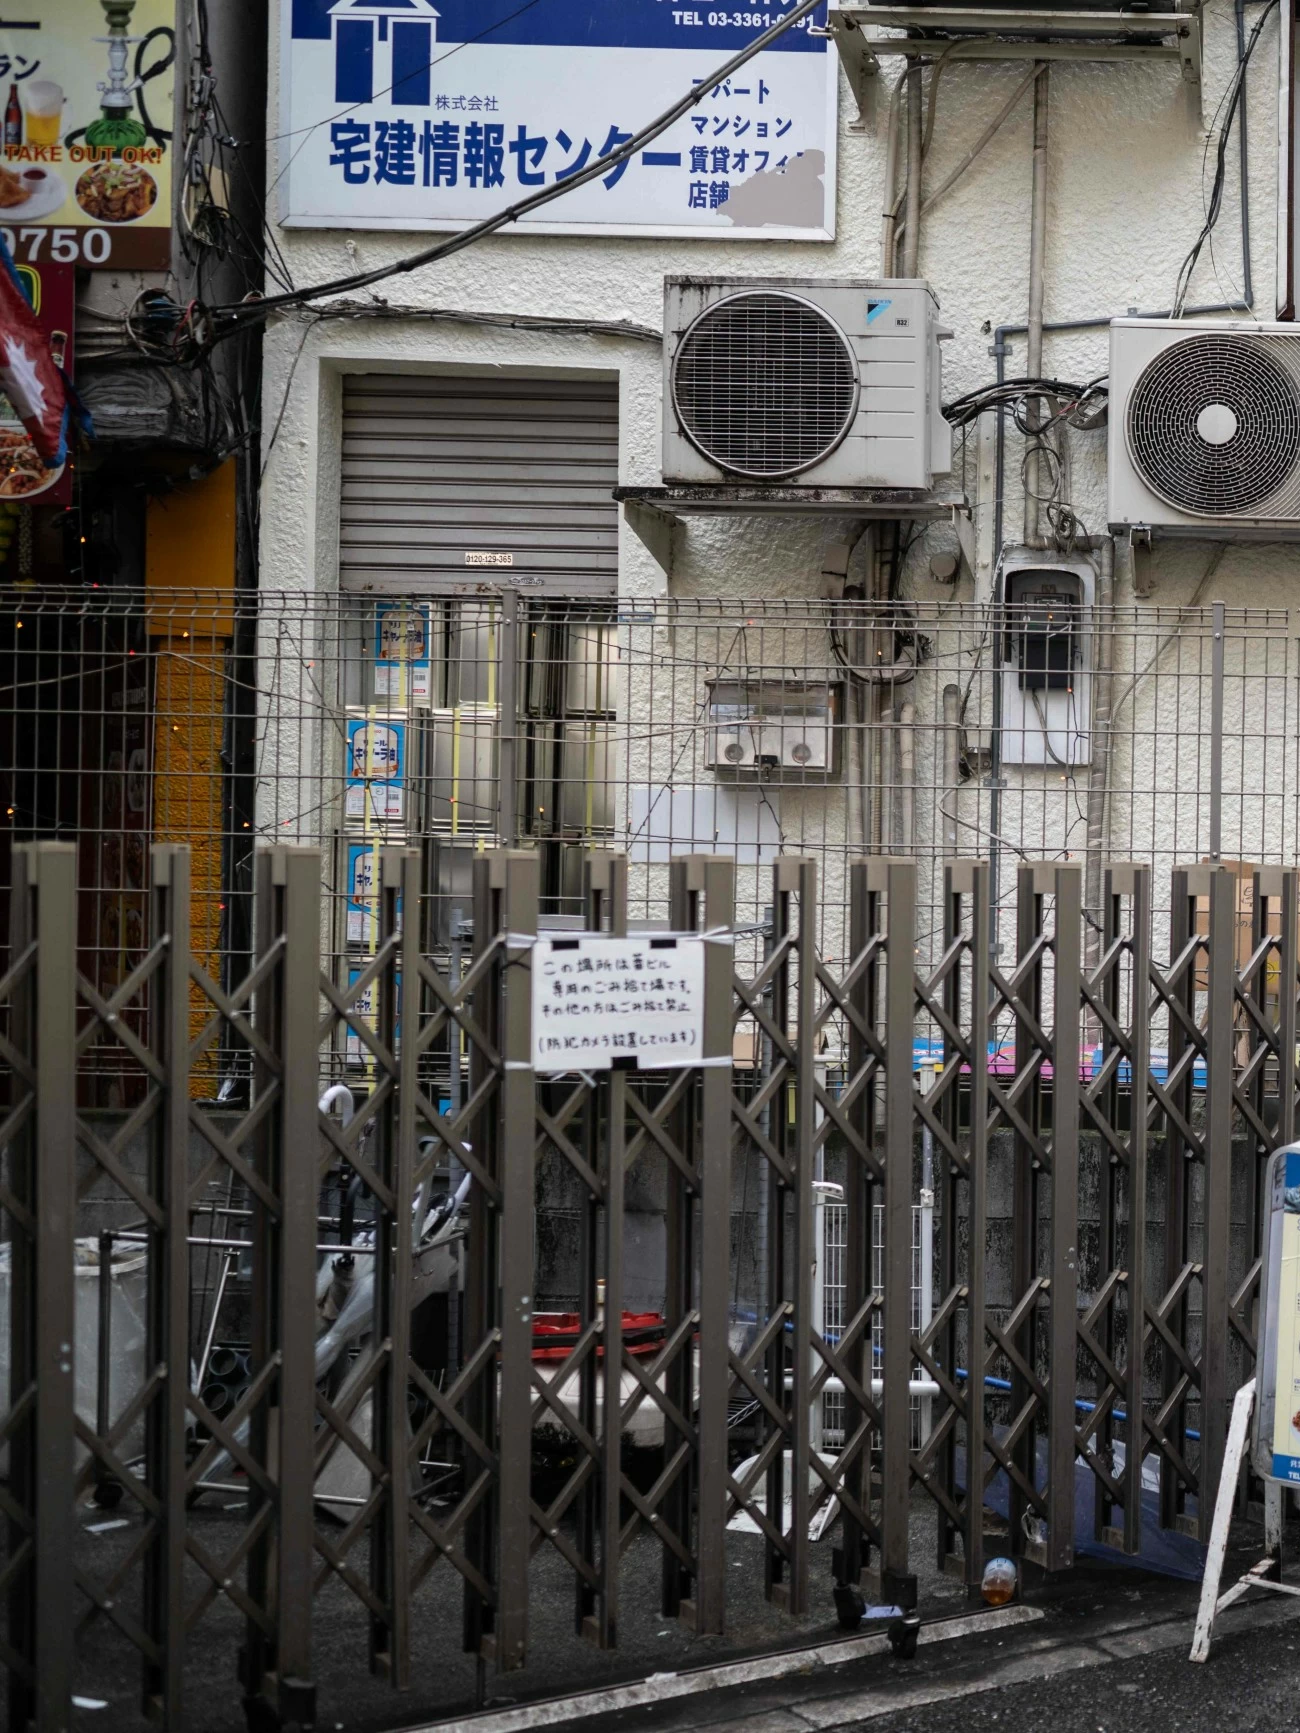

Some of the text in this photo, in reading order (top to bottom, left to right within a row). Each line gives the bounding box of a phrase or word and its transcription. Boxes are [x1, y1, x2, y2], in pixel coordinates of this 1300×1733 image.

[672, 11, 814, 28] TEL 03-3361-091
[692, 78, 770, 104] パート
[435, 94, 499, 112] 株式会社
[691, 115, 792, 138] マンション
[7, 147, 162, 164] TAKE OUT OK!
[330, 118, 682, 190] 宅建情報センター
[689, 145, 804, 174] 賃貸オフィ
